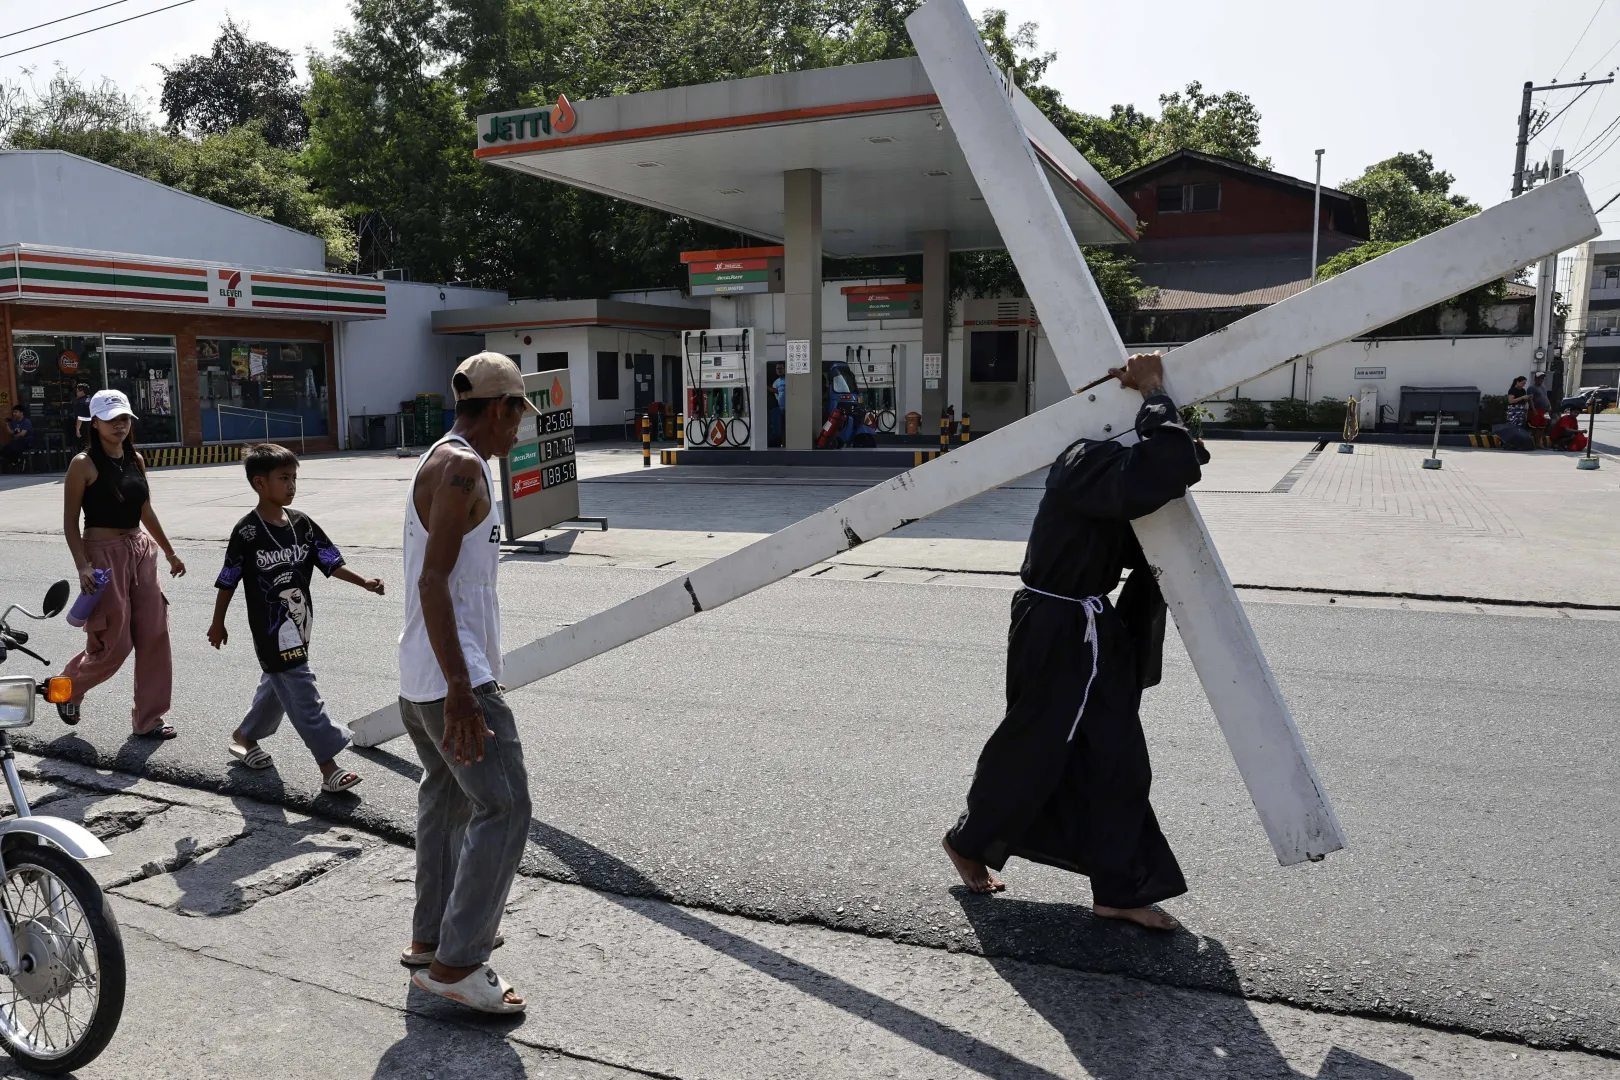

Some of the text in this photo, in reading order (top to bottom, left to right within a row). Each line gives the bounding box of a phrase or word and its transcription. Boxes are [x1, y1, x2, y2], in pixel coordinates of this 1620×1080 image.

[482, 111, 550, 143] JETTI
[774, 268, 781, 281] 1
[218, 270, 241, 307] 7
[912, 299, 921, 310] 3
[525, 389, 550, 409] TTI
[546, 437, 574, 459] 37.70
[548, 462, 575, 485] 88.50
[281, 648, 303, 661] THE
